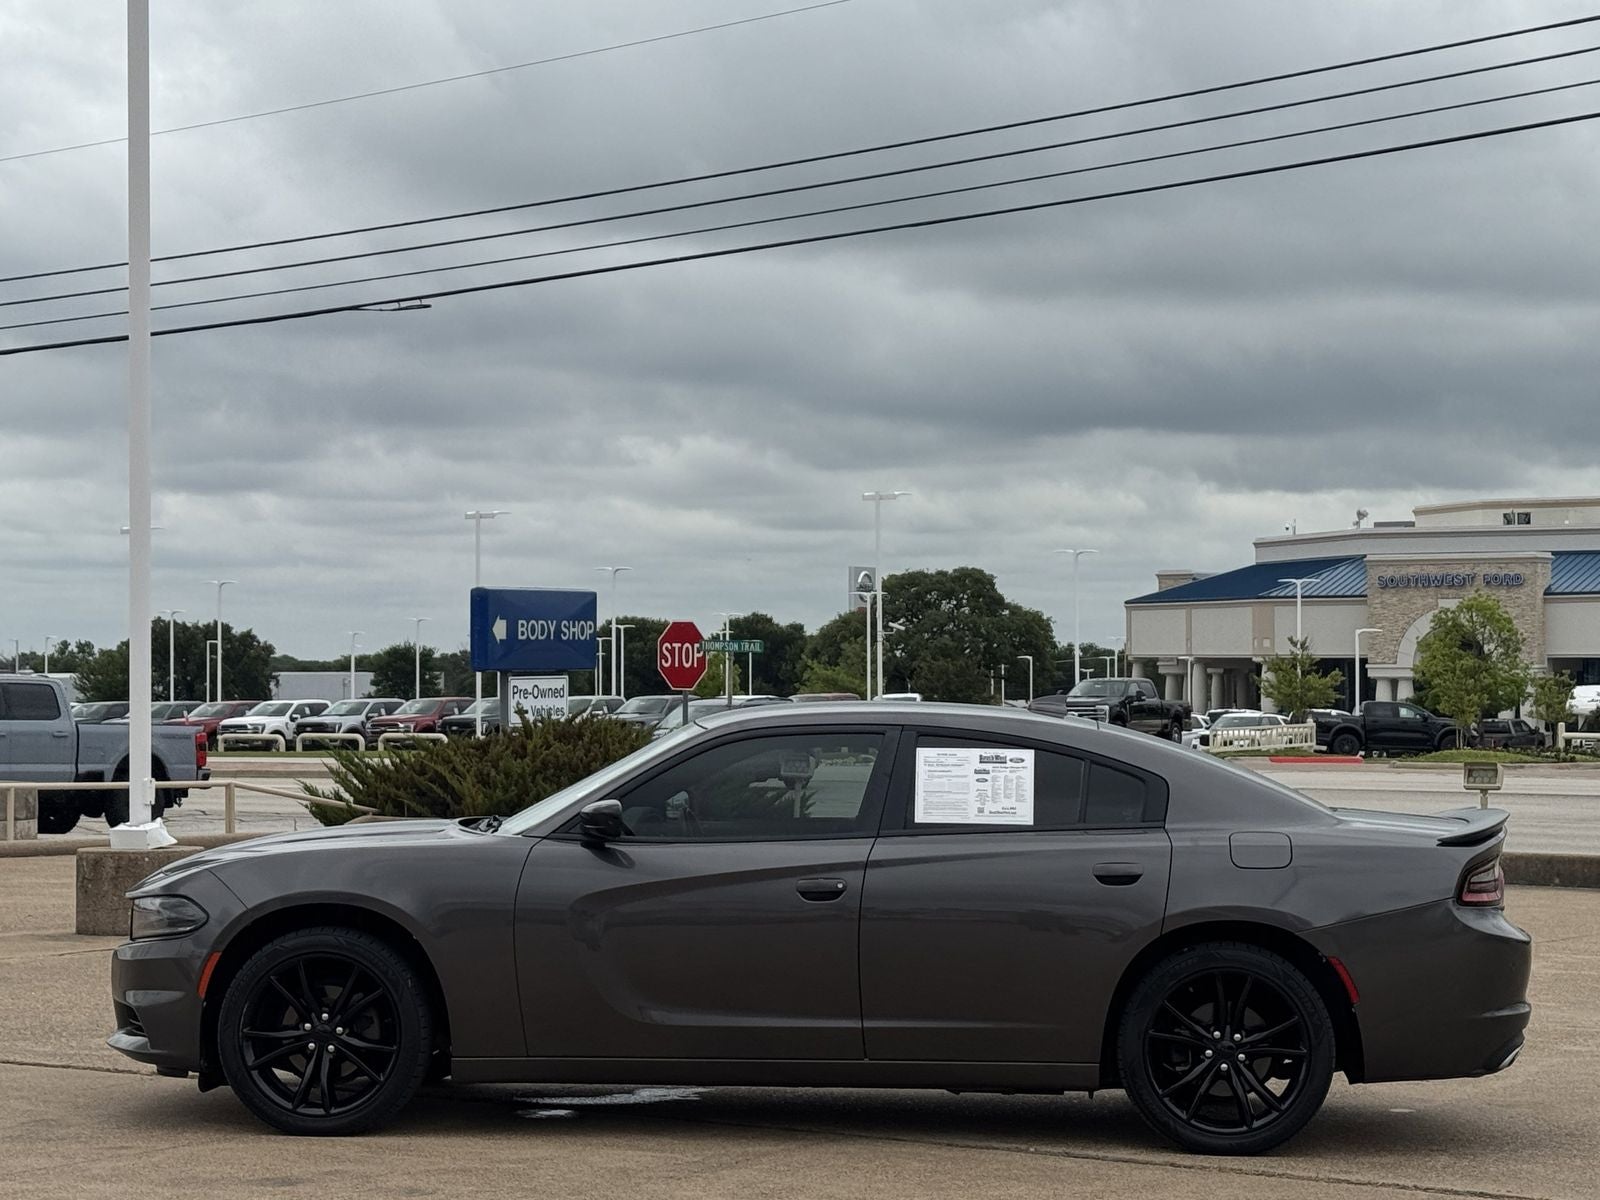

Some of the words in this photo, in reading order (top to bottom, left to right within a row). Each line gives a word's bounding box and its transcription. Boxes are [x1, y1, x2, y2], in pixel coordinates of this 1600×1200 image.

[1377, 573, 1473, 588] SOUTHWEST
[1482, 573, 1524, 586] FORD
[518, 619, 556, 640] BODY
[561, 619, 595, 641] SHOP
[702, 641, 738, 651] THOMPSON
[740, 641, 761, 651] TRAIL
[661, 642, 704, 668] STOP
[512, 684, 565, 700] Pre-Owned
[530, 705, 565, 718] Vehicles
